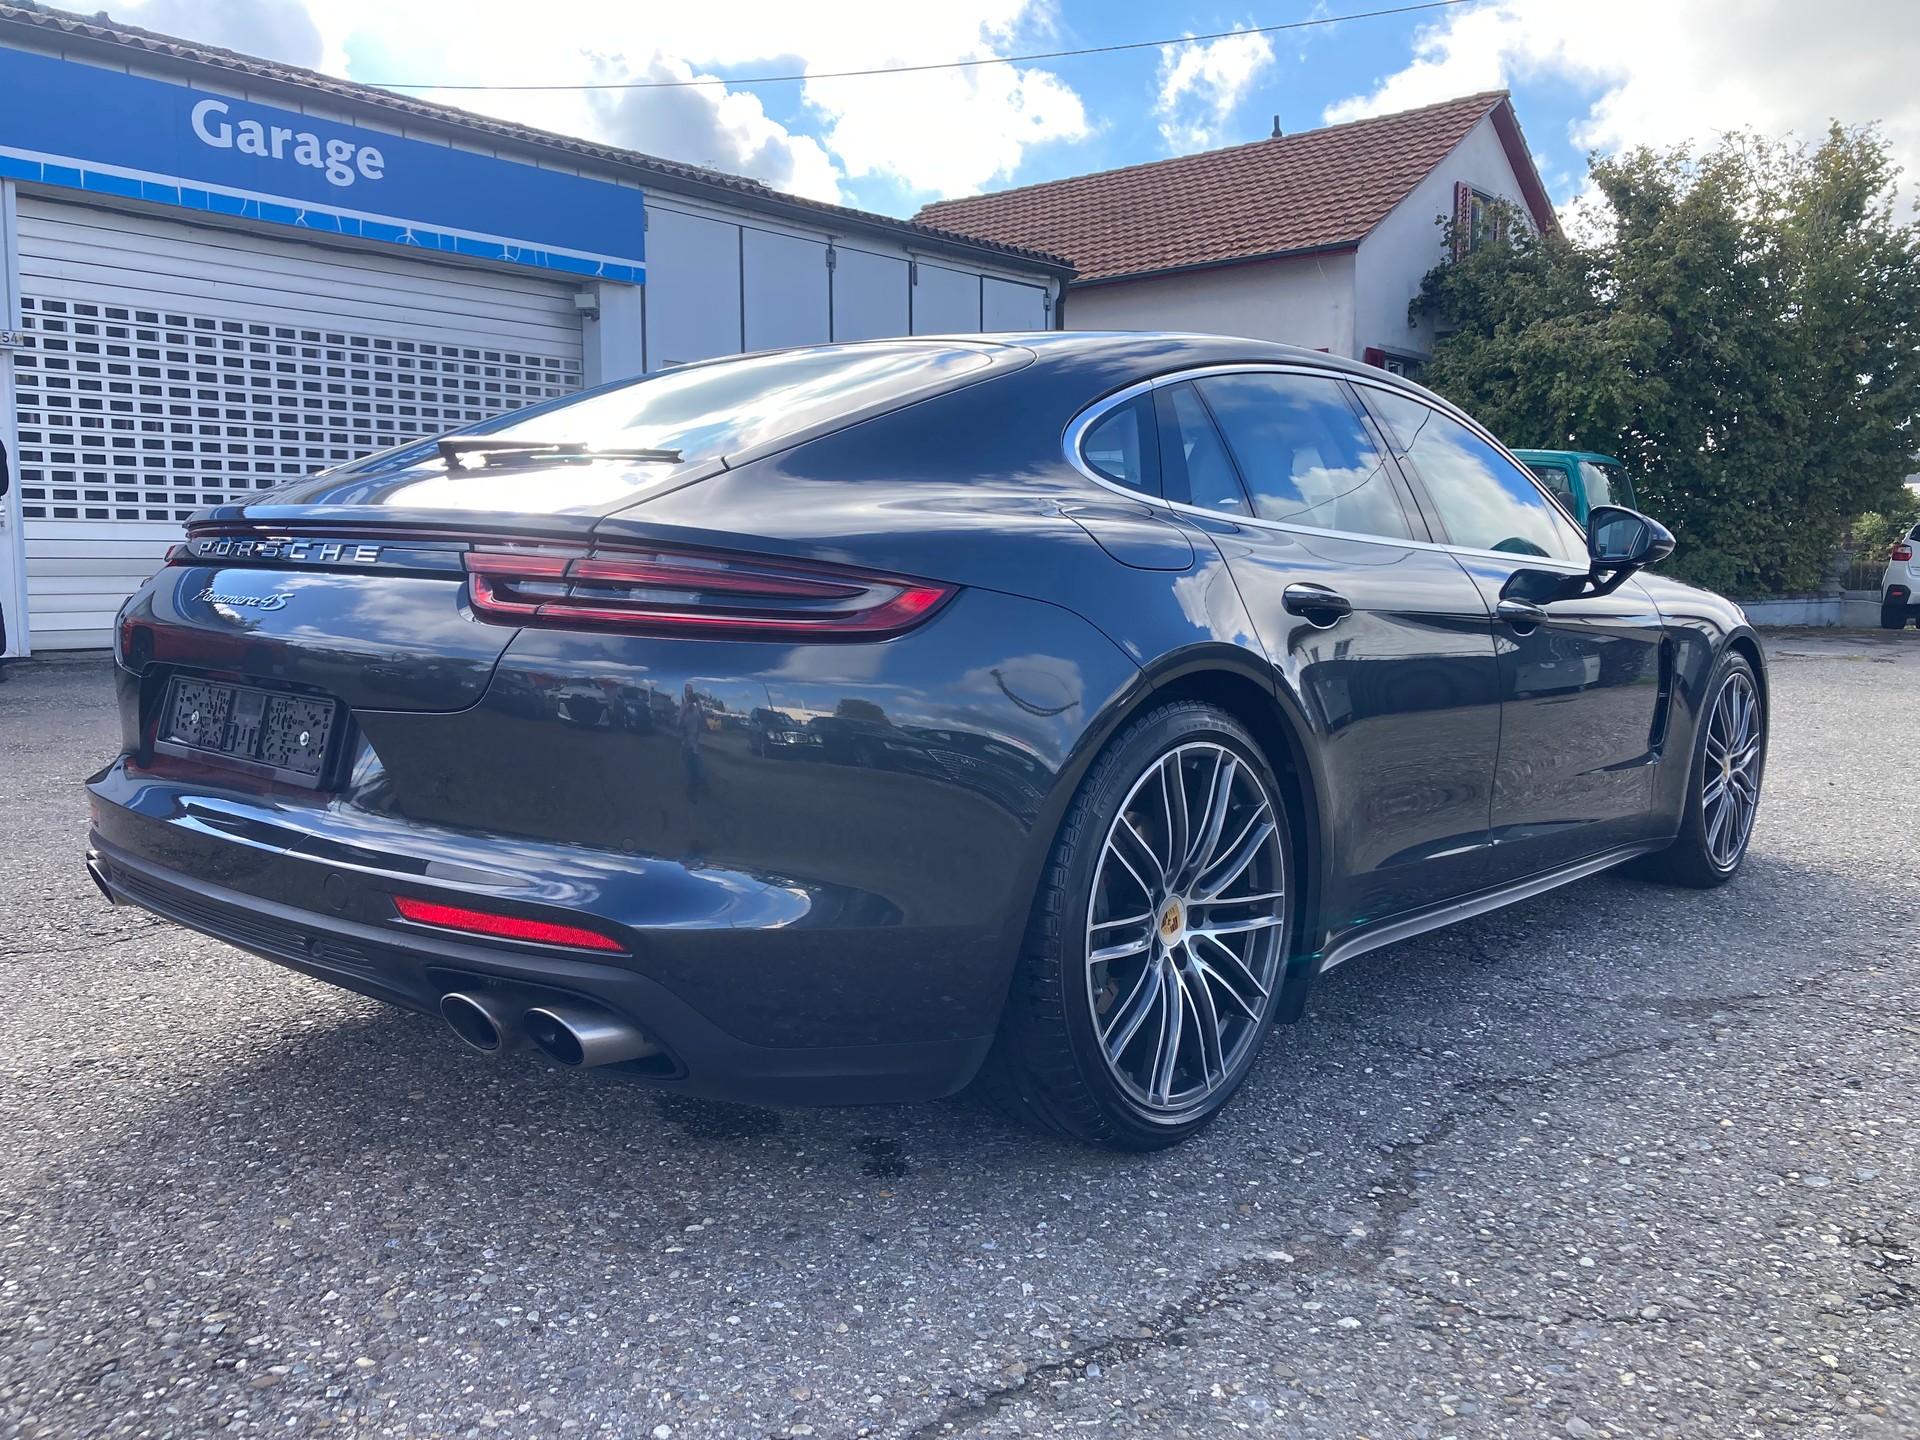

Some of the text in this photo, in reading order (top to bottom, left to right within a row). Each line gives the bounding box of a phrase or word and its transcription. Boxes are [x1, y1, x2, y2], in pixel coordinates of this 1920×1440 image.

[191, 99, 385, 187] Garage
[1, 331, 18, 344] 54
[198, 540, 382, 563] PORSCHE
[192, 587, 295, 611] Panamera 4S
